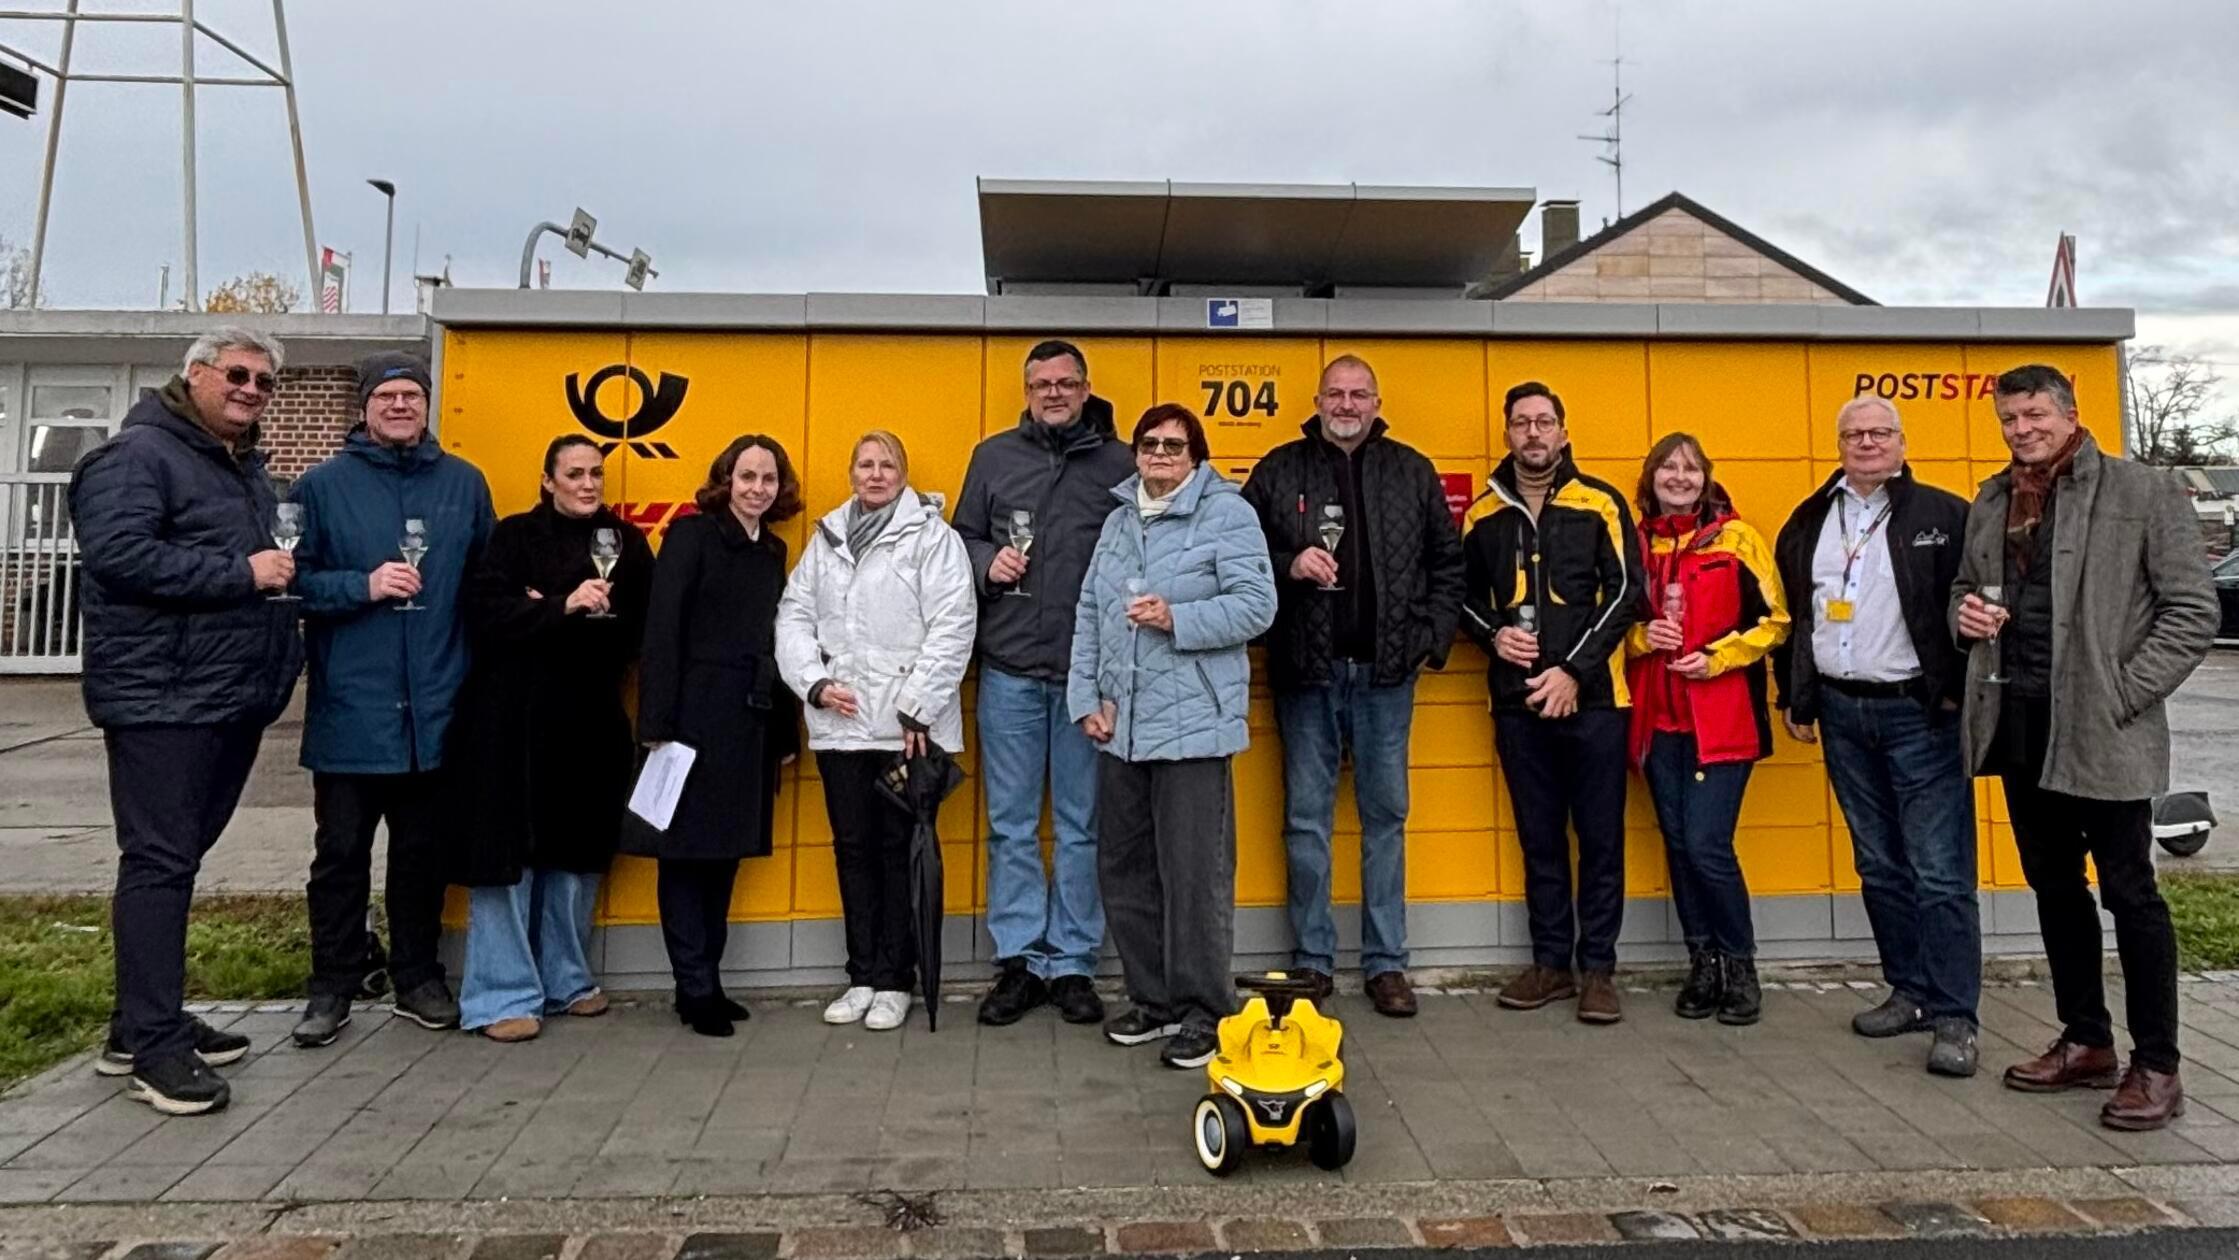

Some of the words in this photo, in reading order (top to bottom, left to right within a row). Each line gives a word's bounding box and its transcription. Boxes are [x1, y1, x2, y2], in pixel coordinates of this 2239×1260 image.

[1200, 364, 1280, 376] POSTSTATION
[1201, 380, 1279, 417] 704
[1854, 373, 2076, 400] POSTSTA
